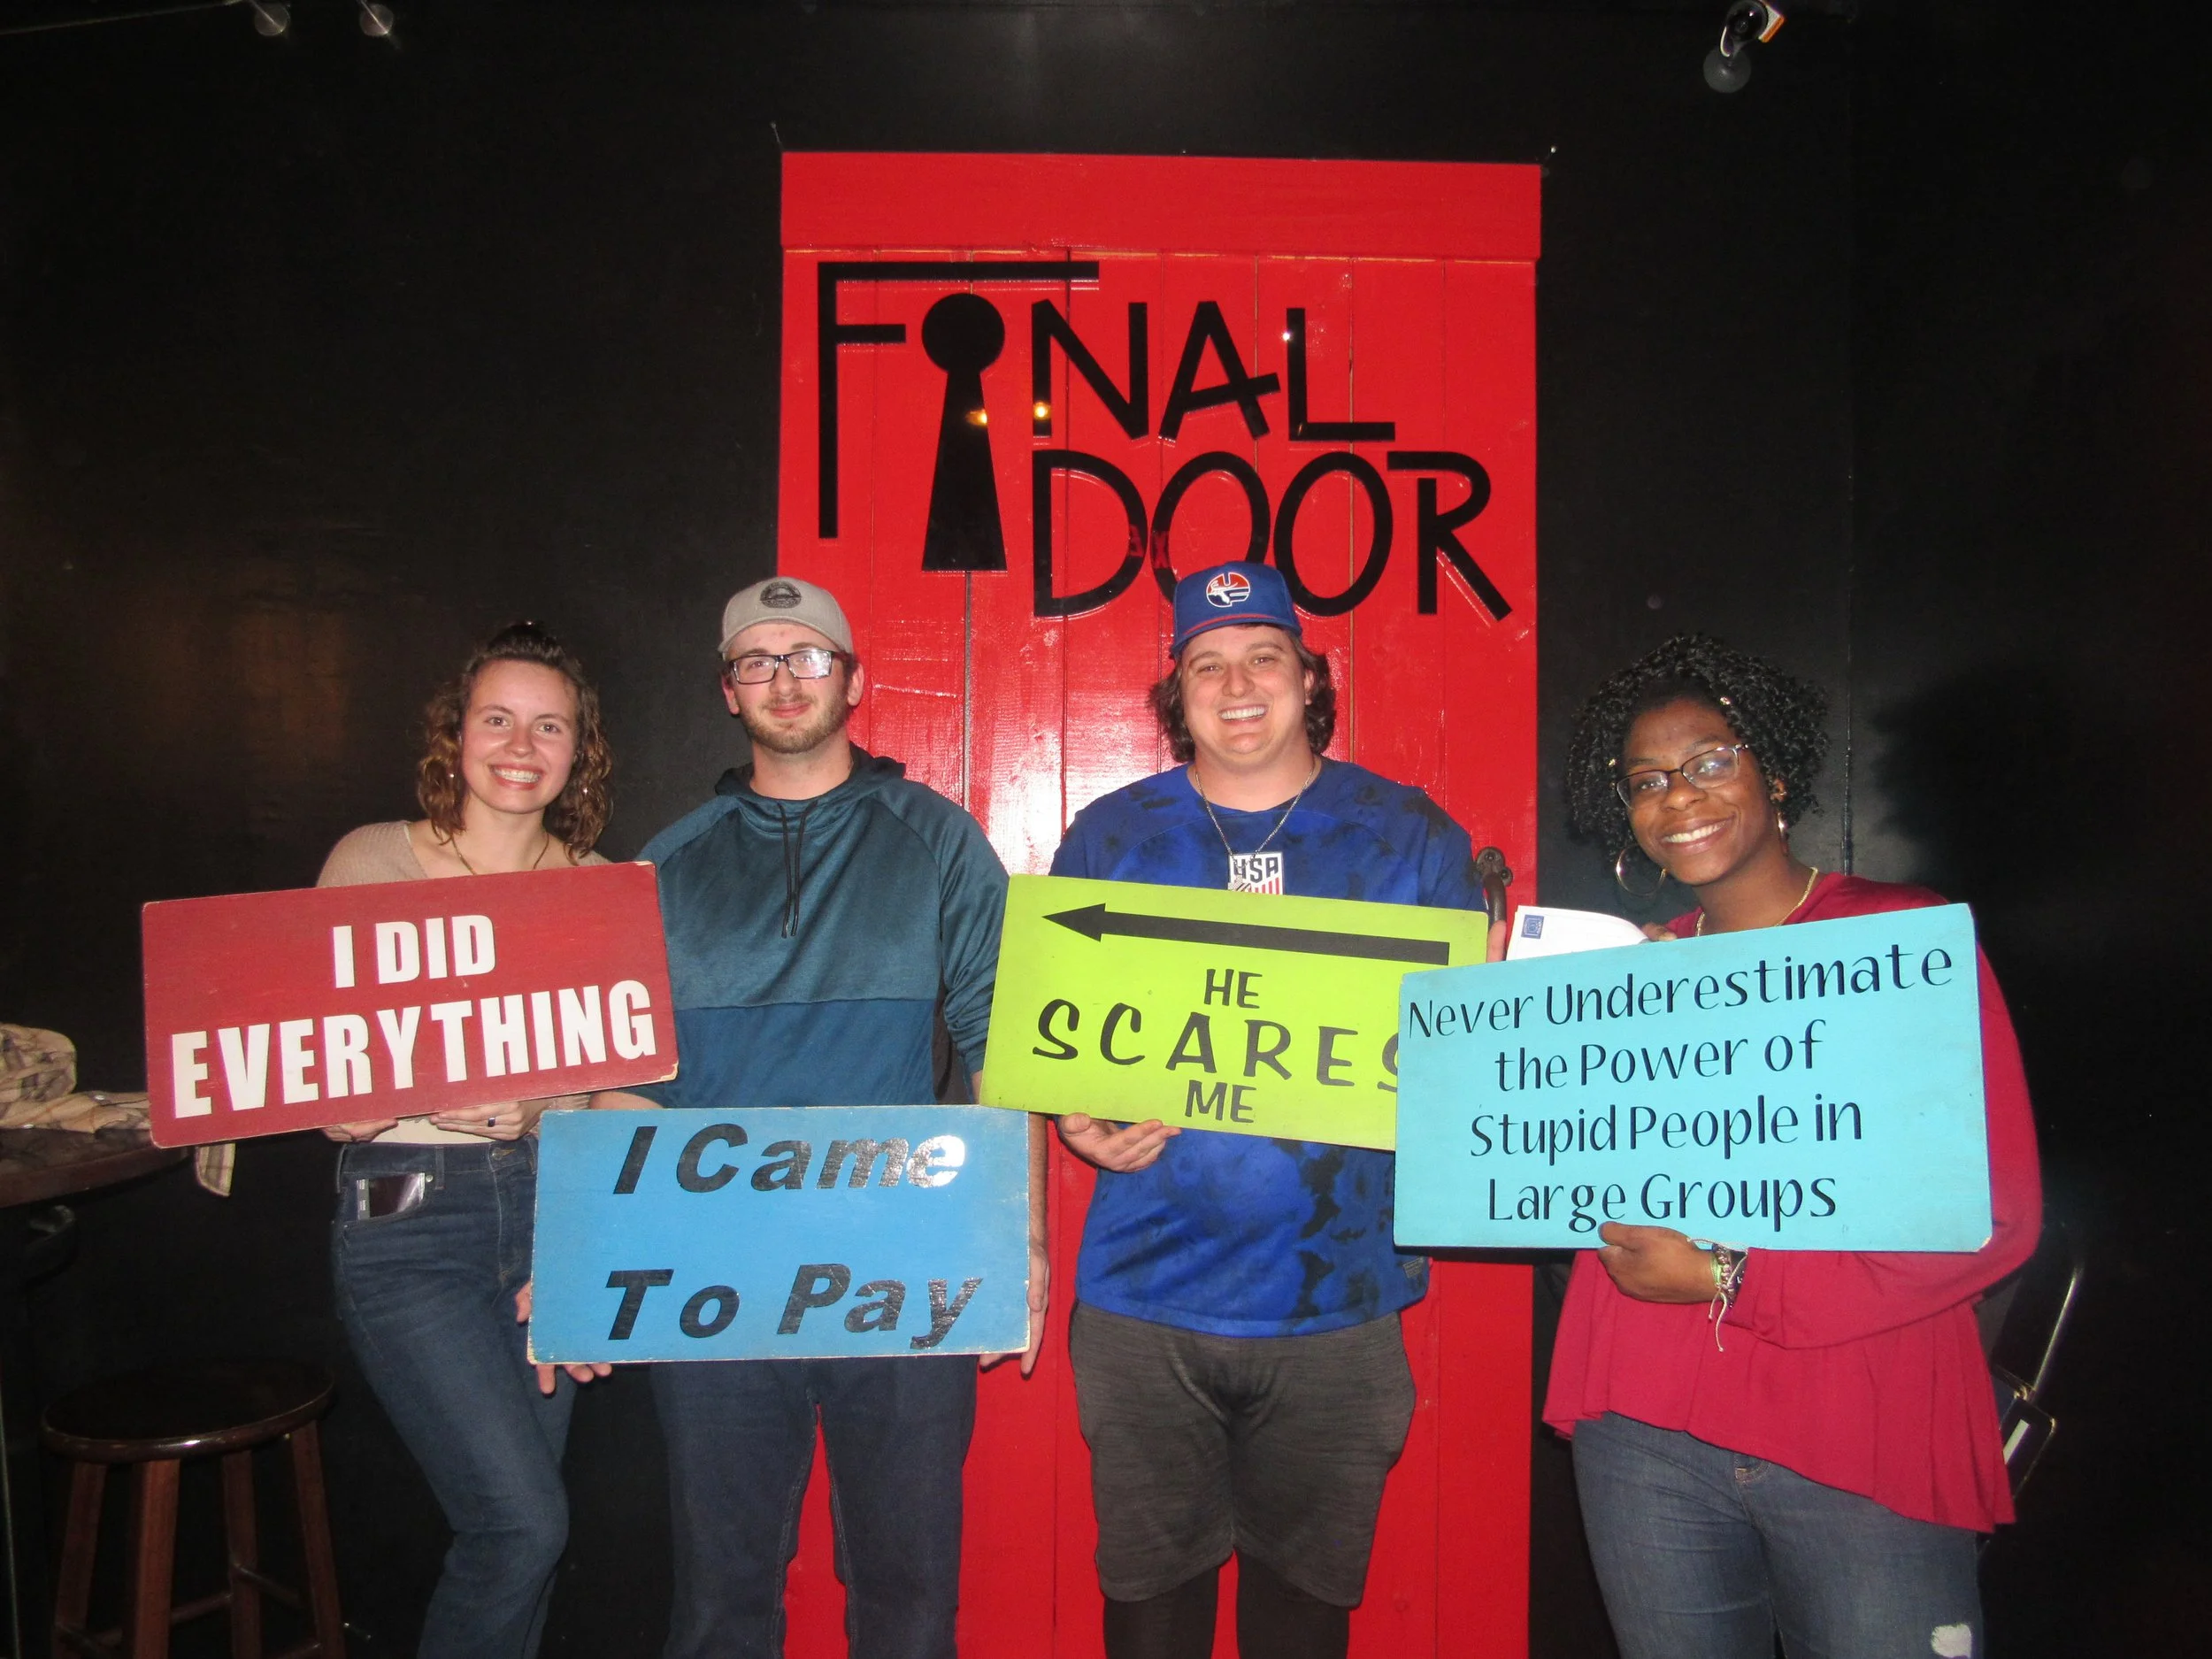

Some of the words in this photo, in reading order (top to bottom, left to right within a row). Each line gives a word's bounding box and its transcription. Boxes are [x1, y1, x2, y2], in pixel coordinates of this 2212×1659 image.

[818, 261, 1395, 572] FINAL
[1033, 449, 1511, 620] DOOR
[1233, 856, 1279, 883] USA
[332, 926, 356, 989] I
[375, 915, 495, 985] DID
[1203, 968, 1263, 1009] HE
[1409, 995, 1534, 1038] Never
[1545, 944, 1954, 1025] Underestimate
[171, 979, 657, 1118] EVERYTHING
[1494, 1048, 1568, 1092] the
[1579, 1036, 1748, 1087] Power
[1764, 1018, 1826, 1072] of
[1185, 1079, 1256, 1123] ME
[1470, 1104, 1617, 1165] Stupid
[1629, 1094, 1799, 1159] People
[1815, 1094, 1863, 1141] in
[612, 1125, 657, 1194] I
[676, 1123, 965, 1193] Came
[1488, 1178, 1626, 1233] Large
[1640, 1173, 1837, 1232] Groups
[605, 1269, 740, 1340] To
[777, 1263, 983, 1349] Pay
